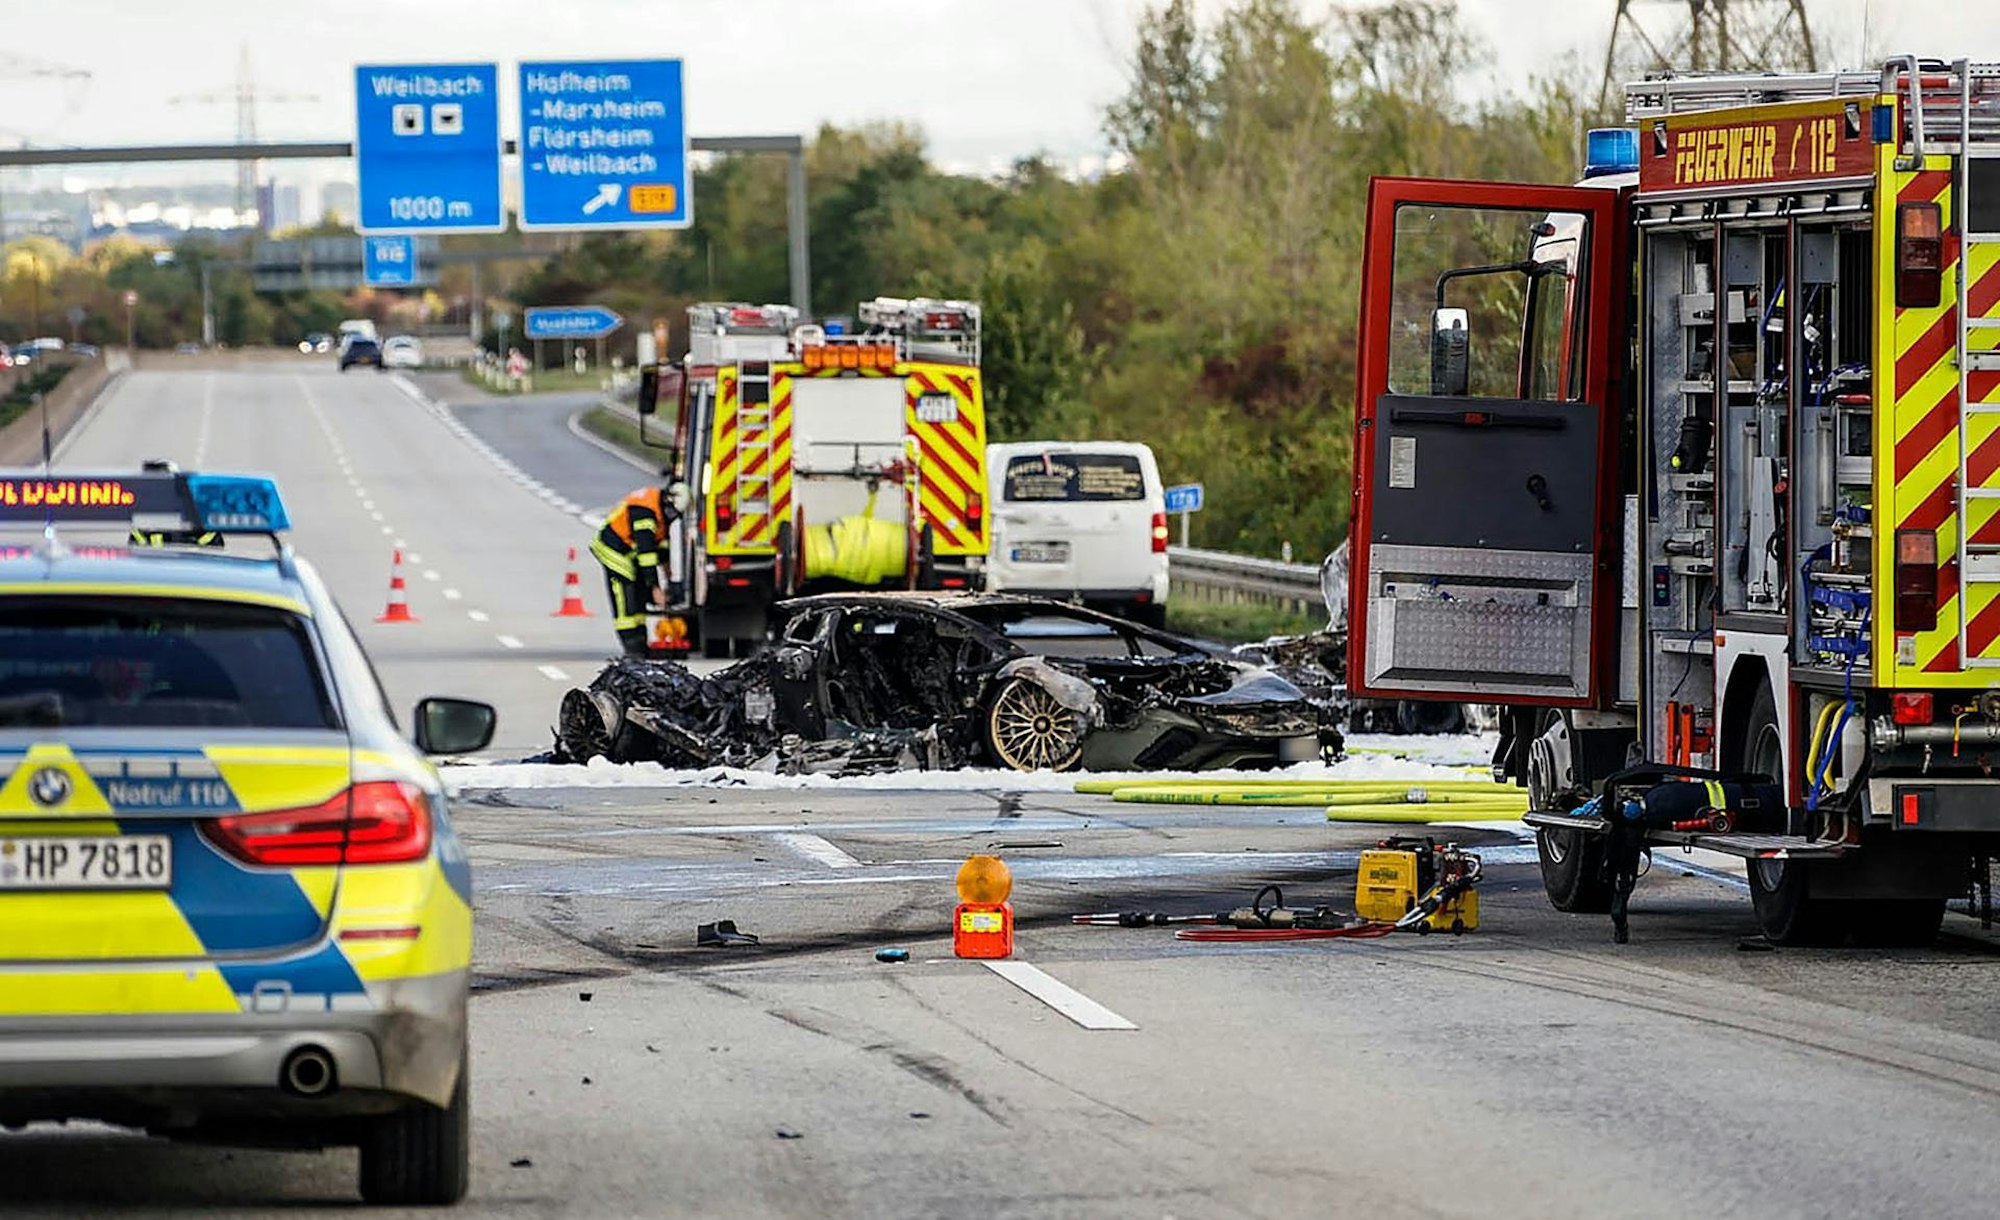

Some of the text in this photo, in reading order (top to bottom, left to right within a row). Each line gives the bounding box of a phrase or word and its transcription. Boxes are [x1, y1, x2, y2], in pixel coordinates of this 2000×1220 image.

[371, 74, 484, 97] Weilbach
[526, 70, 632, 94] Hofheim
[1675, 118, 1837, 185] FEUERWEHR 112
[389, 196, 473, 220] 1000 m
[108, 782, 229, 806] Notruf 110
[24, 842, 165, 880] HP 7818
